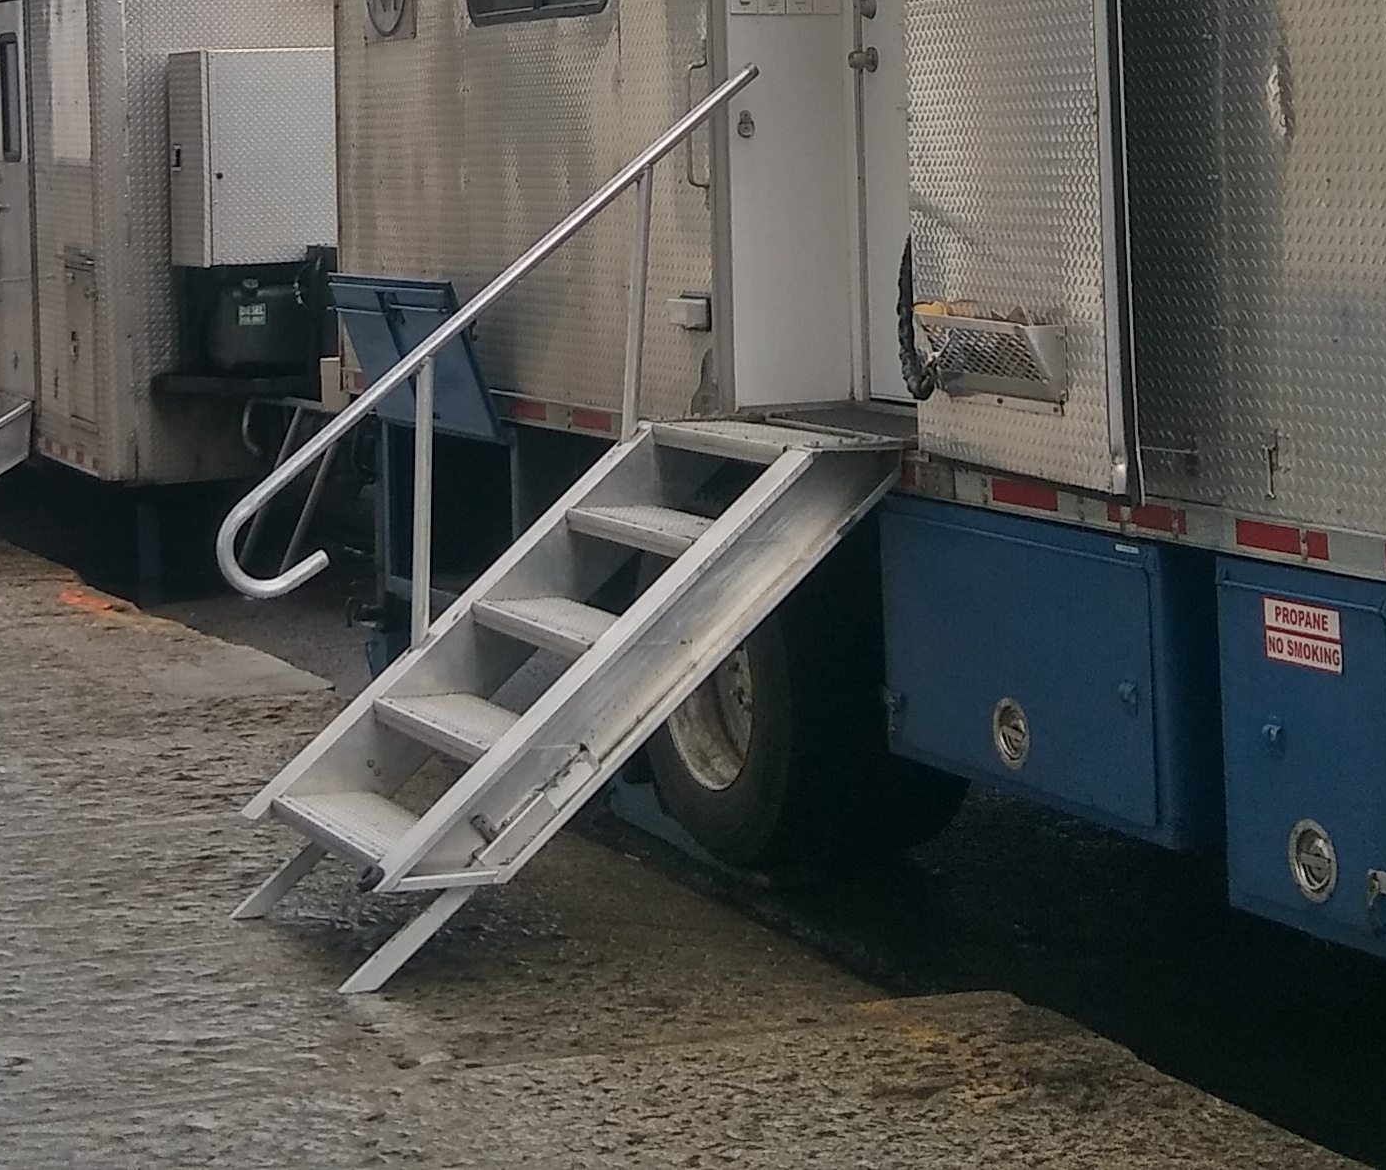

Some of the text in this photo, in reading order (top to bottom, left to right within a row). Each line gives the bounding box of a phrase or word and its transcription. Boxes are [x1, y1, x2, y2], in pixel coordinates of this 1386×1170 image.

[1274, 605, 1330, 632] PROPANE
[1268, 635, 1340, 666] NO SMOKING
